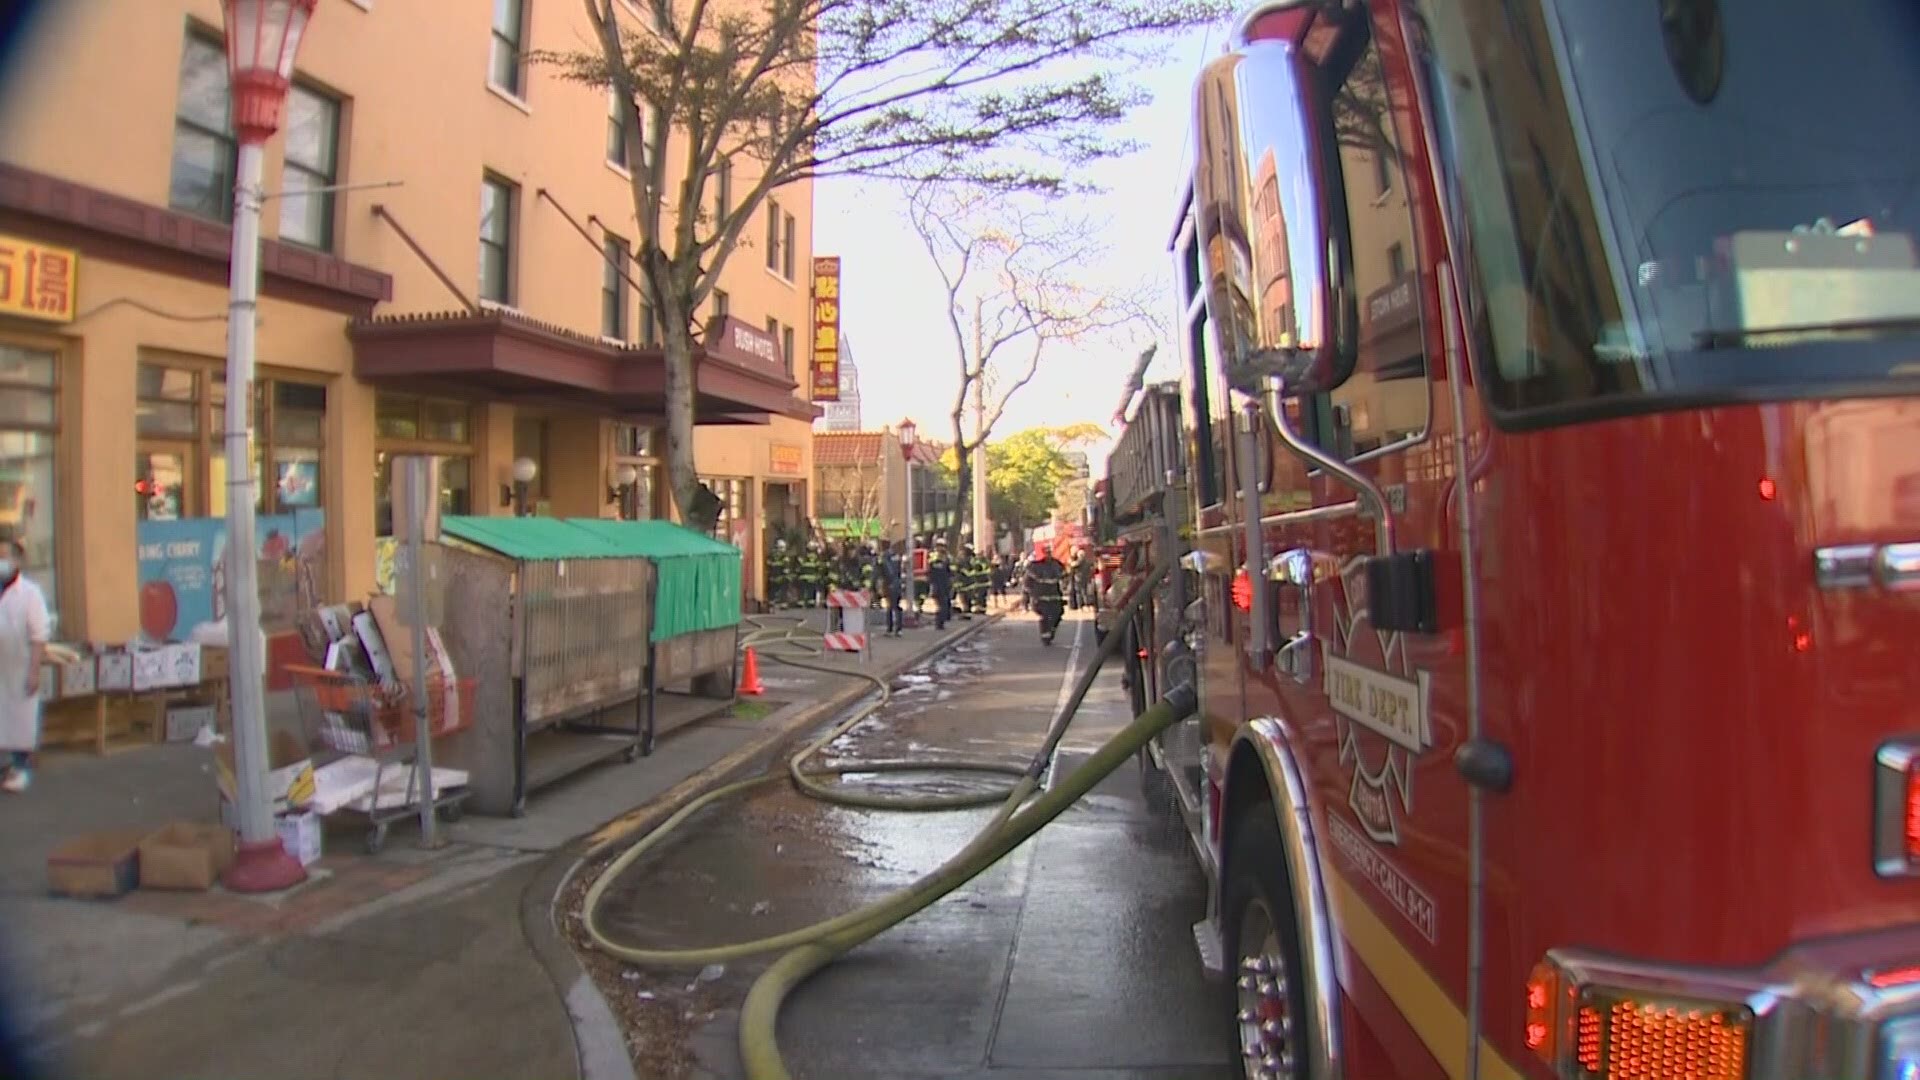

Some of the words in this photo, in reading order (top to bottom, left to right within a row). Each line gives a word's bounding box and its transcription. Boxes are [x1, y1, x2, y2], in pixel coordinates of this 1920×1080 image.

[735, 327, 754, 353] BUSH
[754, 335, 774, 362] HOTEL
[1333, 669, 1362, 713] FIRE
[1367, 682, 1412, 735] DEPT.
